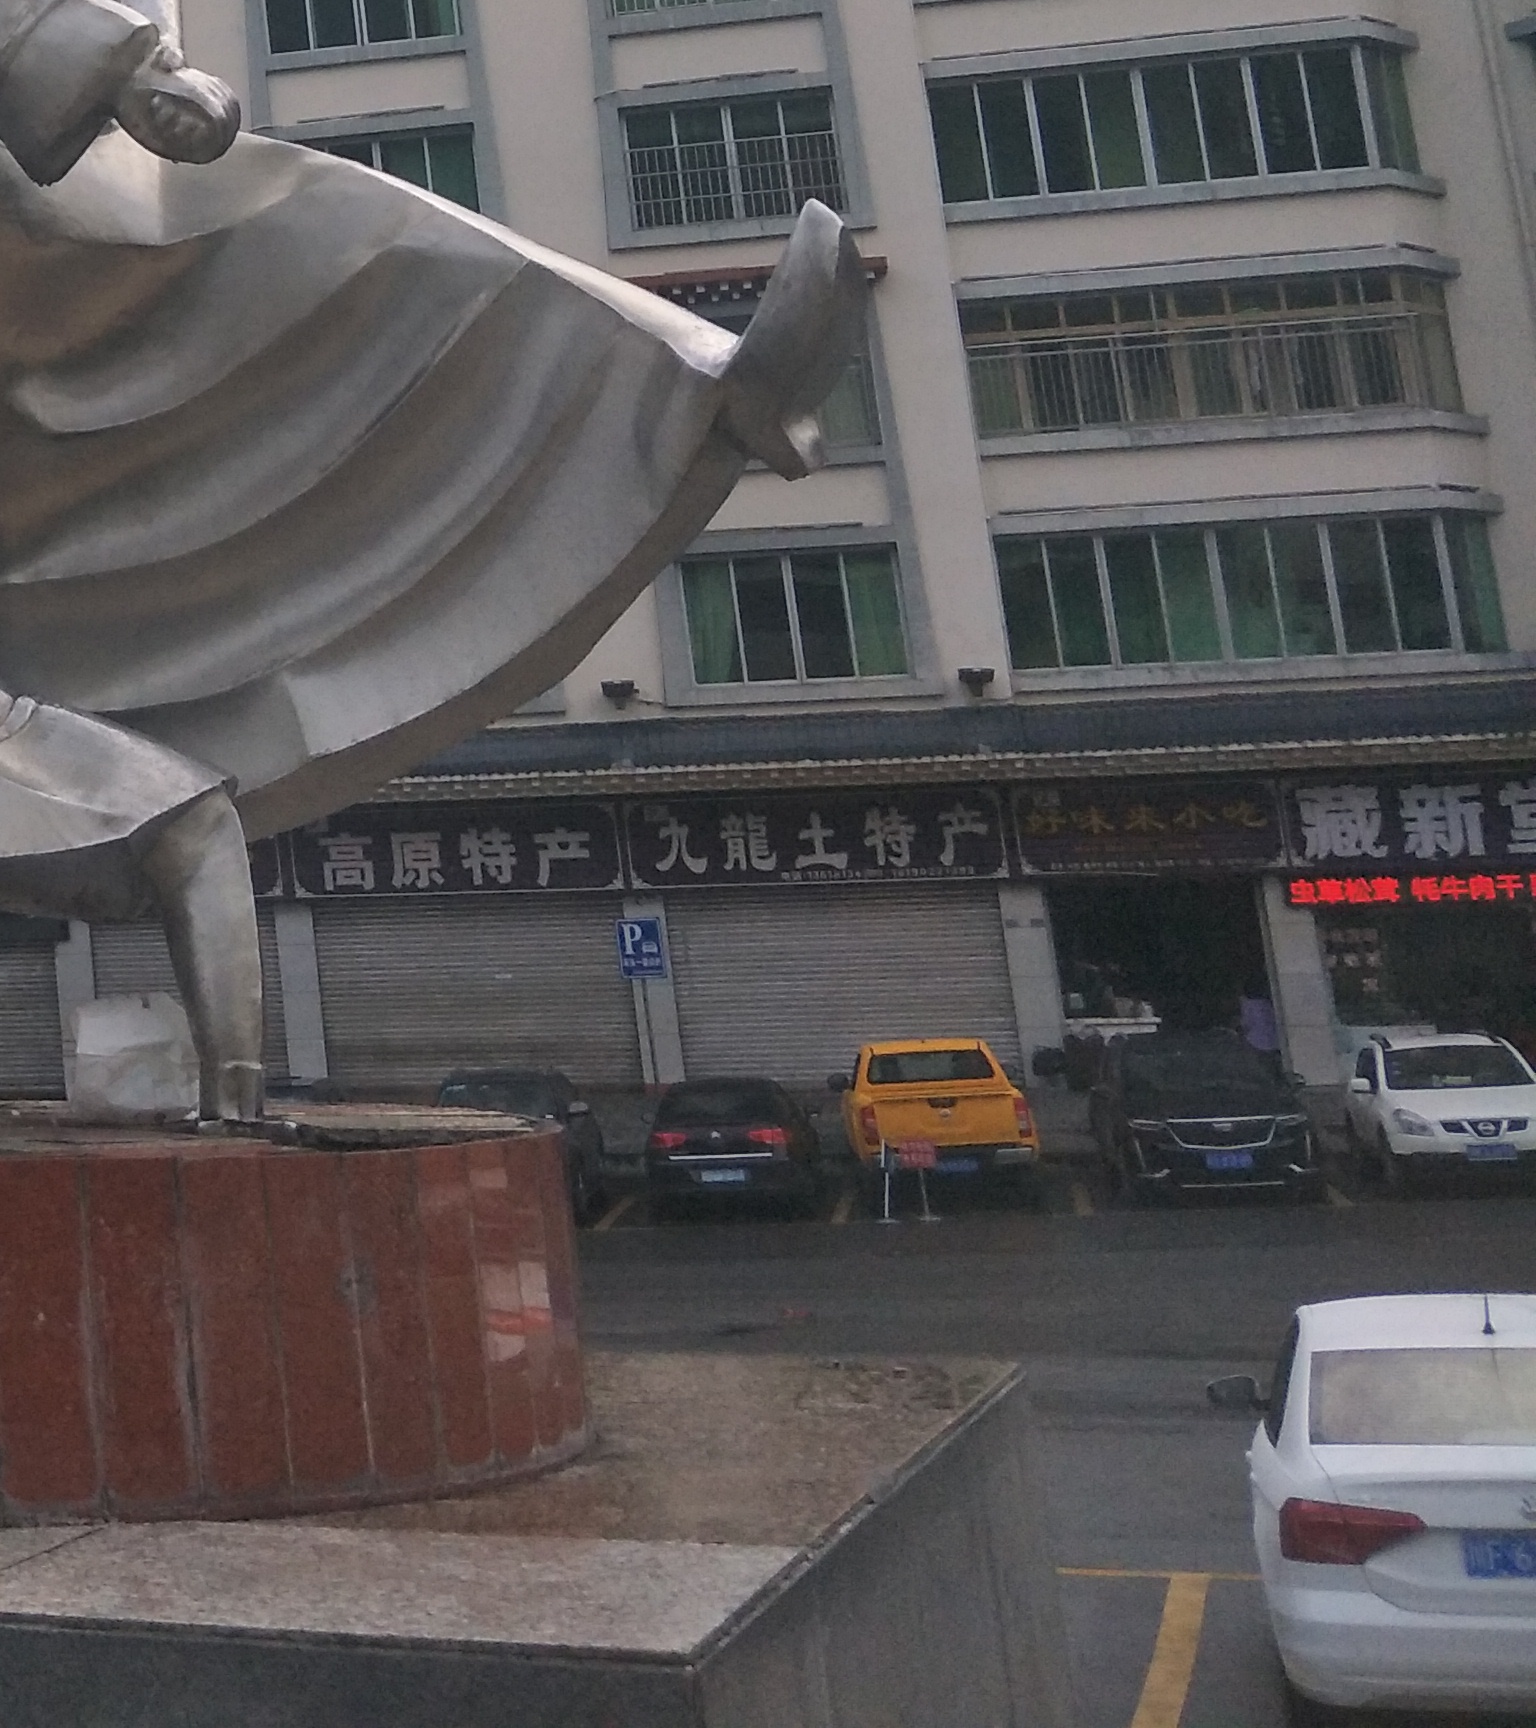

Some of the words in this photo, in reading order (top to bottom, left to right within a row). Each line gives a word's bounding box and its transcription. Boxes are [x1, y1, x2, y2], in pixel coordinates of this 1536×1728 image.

[318, 826, 590, 891] 高原特产
[655, 803, 989, 876] 九龍土特产
[1289, 876, 1401, 905] 虫草松茸
[1410, 874, 1525, 903] 牦牛肉干
